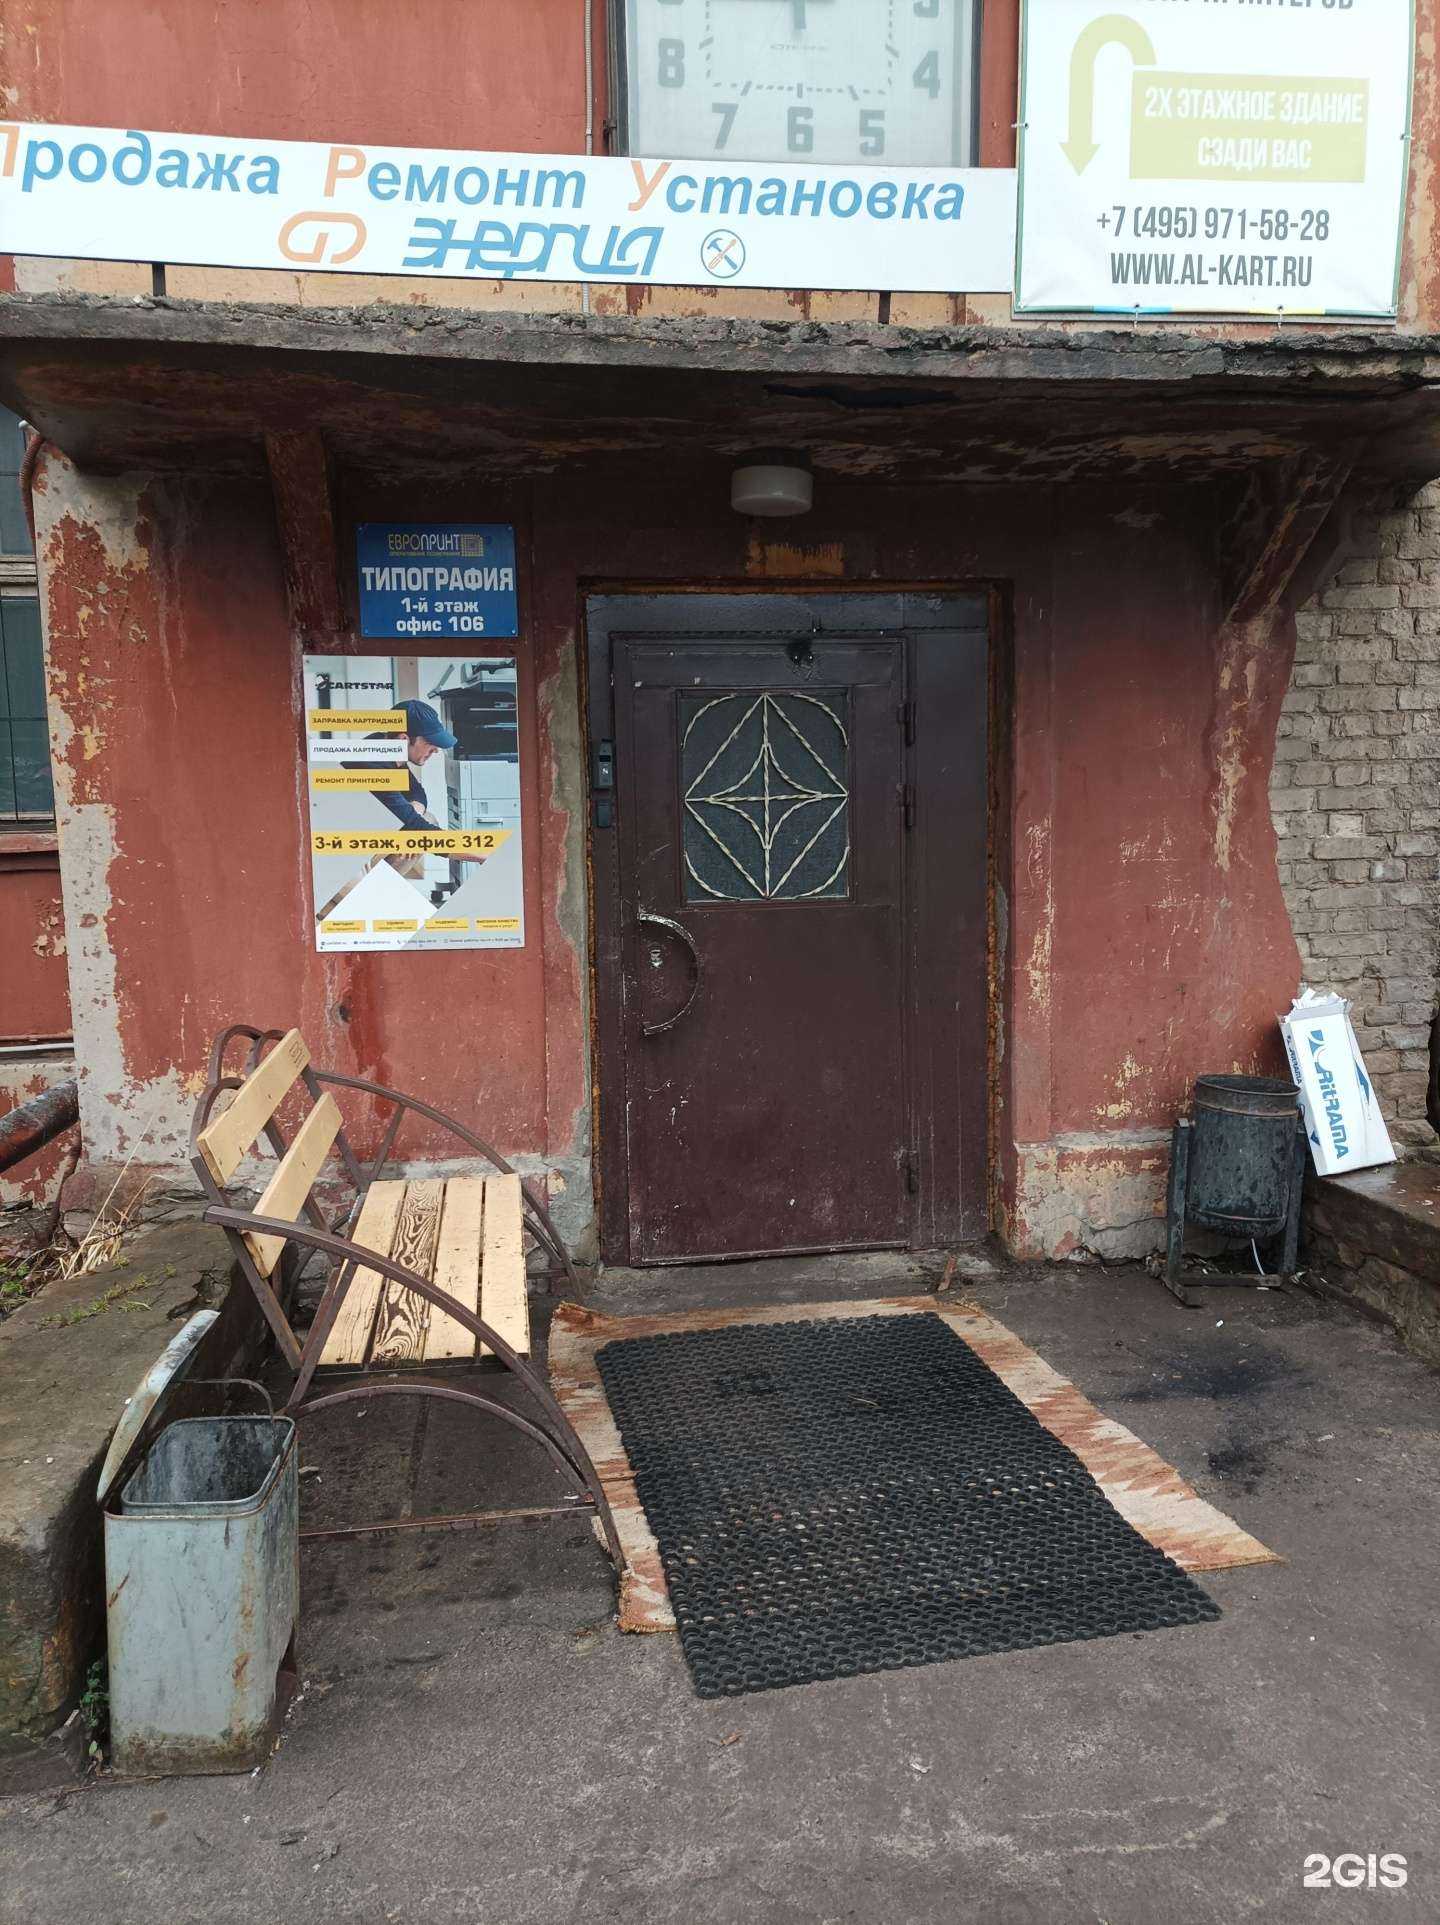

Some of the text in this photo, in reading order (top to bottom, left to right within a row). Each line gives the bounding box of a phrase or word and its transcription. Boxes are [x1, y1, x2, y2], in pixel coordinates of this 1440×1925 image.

[658, 38, 685, 88] 8
[913, 50, 941, 99] 4
[1177, 88, 1276, 121] ЭТАЖНОЕ
[1279, 91, 1364, 125] ЗДАНИЕ
[711, 103, 739, 150] 7
[787, 106, 813, 153] 6
[859, 109, 886, 156] 5
[1198, 137, 1312, 171] СЗАДИ ВАС
[323, 146, 586, 209] Ремонт
[627, 160, 965, 220] Установка
[1096, 206, 1330, 241] +7 (495) 971-58-28
[1110, 252, 1313, 287] WWW.AL-KART.RU
[362, 567, 514, 591] ТИПОГРАФИЯ
[401, 597, 479, 613] 1-й этаж
[396, 616, 484, 635] офис 106
[353, 716, 403, 725] КАРТРИДЖЕЙ
[353, 745, 403, 753] КАРТРИДЖЕЙ
[315, 835, 494, 851] 3-й этаж, офис 312
